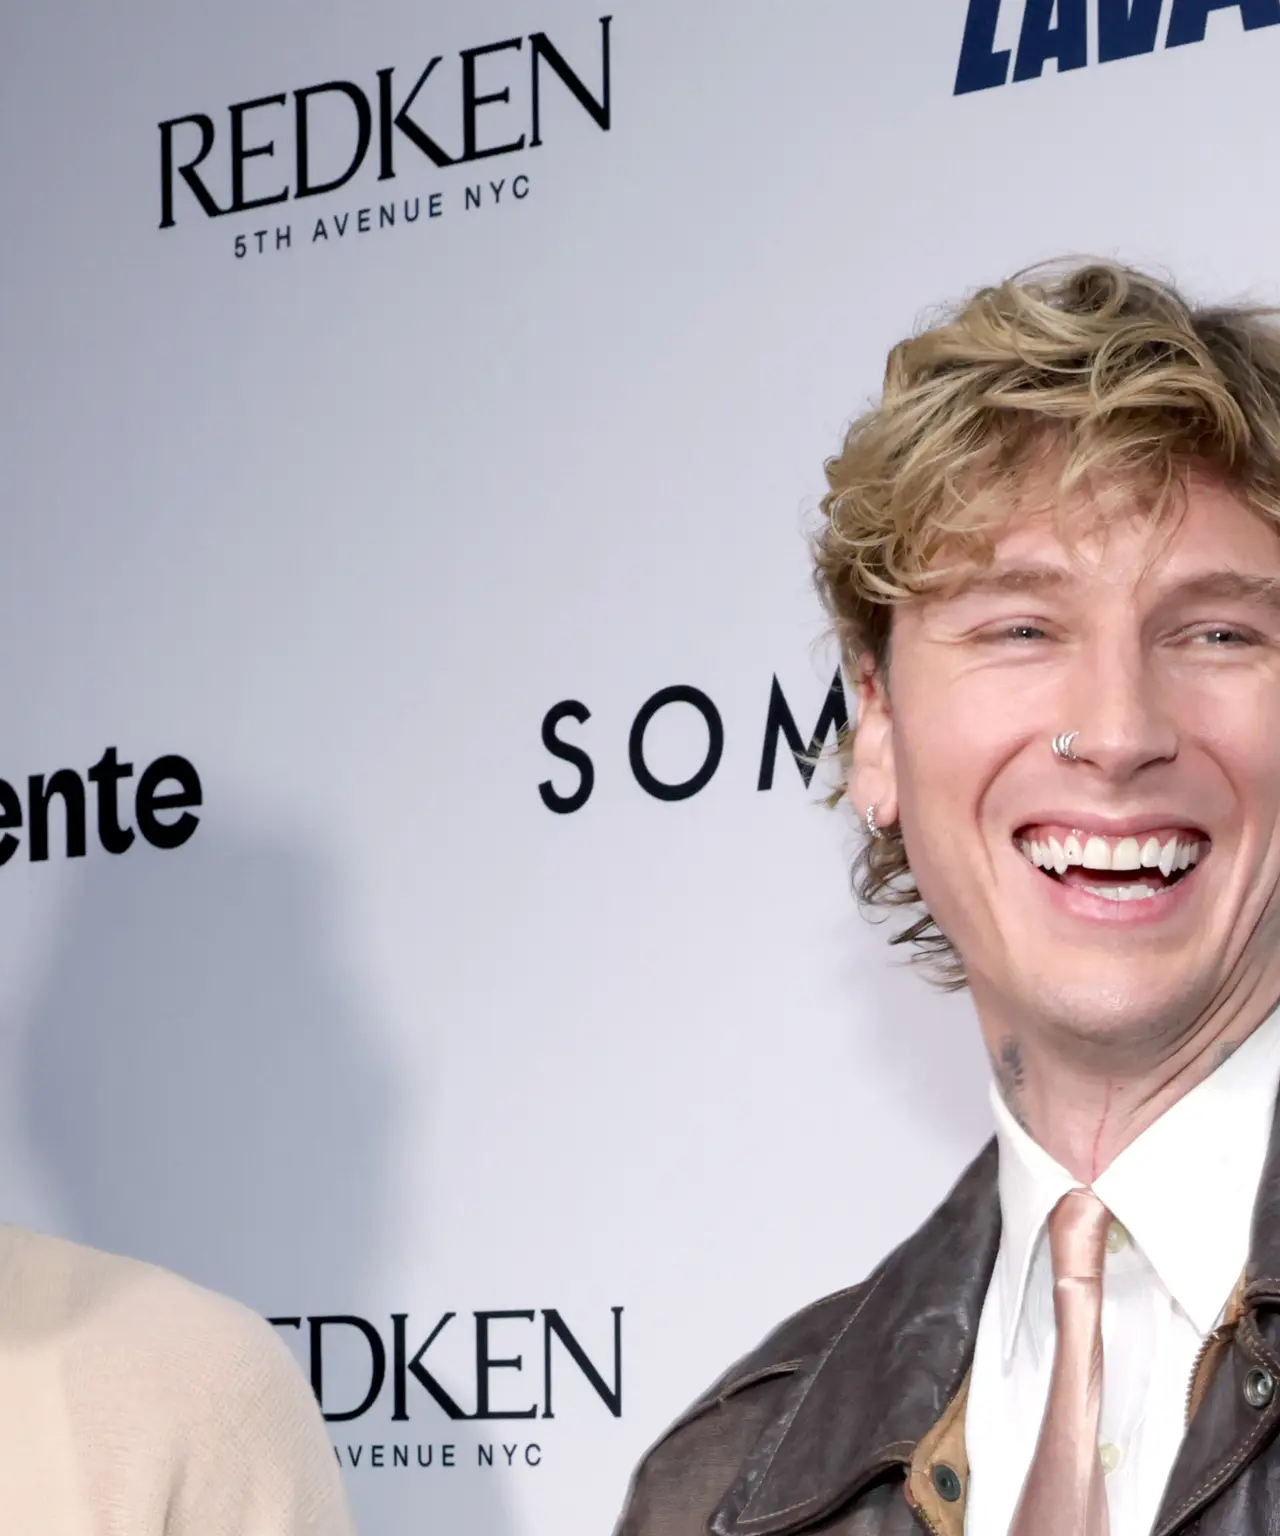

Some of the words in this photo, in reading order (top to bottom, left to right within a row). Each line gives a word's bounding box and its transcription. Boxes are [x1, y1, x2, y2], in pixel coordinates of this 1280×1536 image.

[157, 15, 613, 229] REDKEN
[234, 225, 292, 259] 5TH
[312, 193, 443, 242] AVENUE
[465, 174, 530, 211] NYC
[265, 1305, 624, 1423] DKEN
[477, 1443, 543, 1467] NYC
